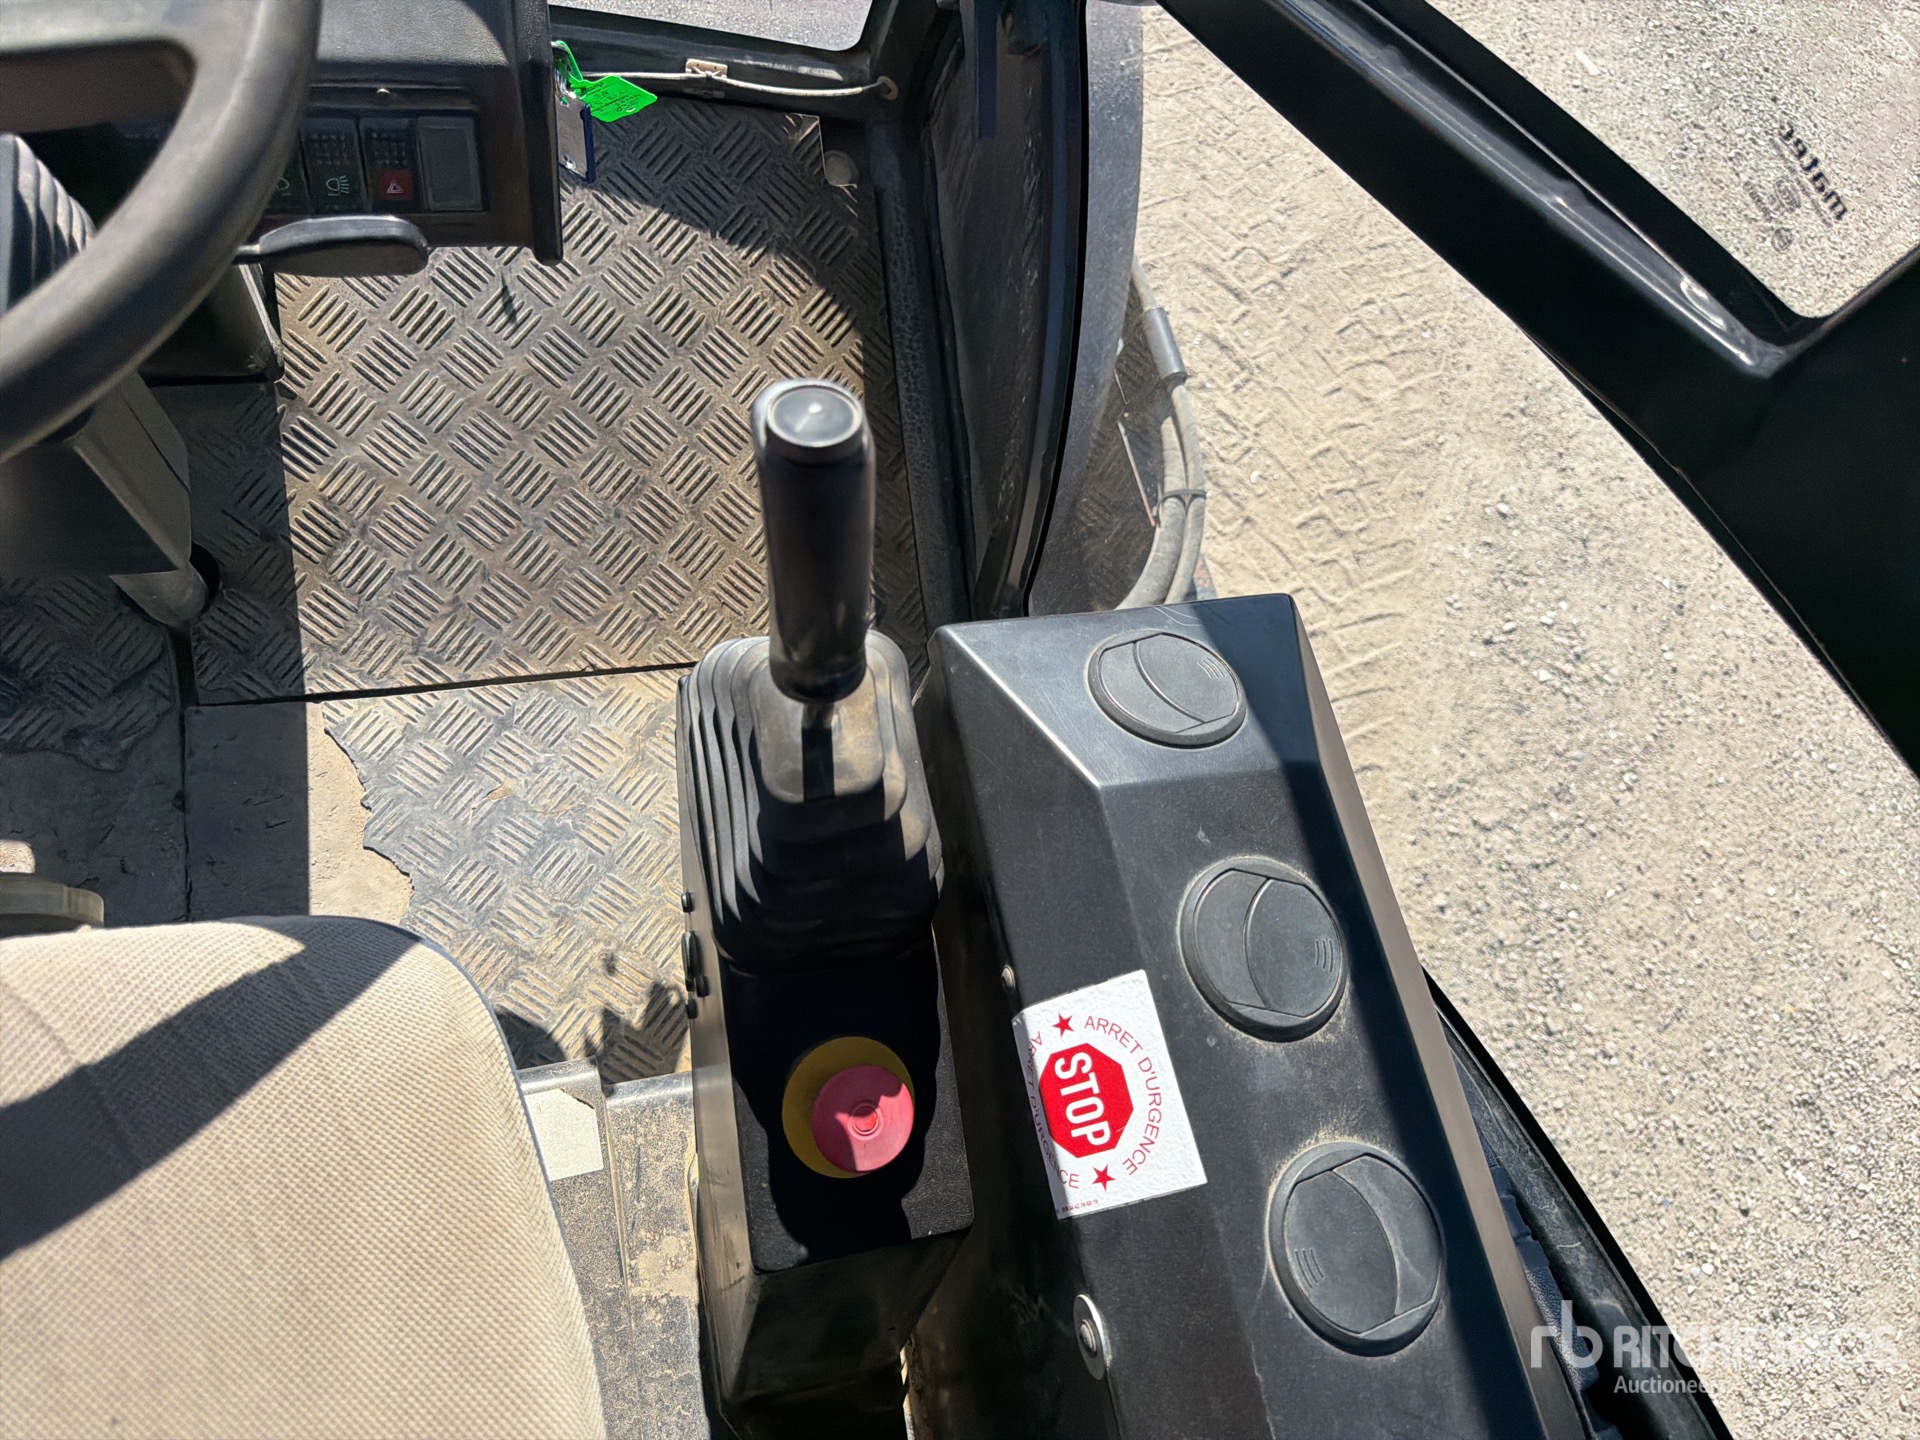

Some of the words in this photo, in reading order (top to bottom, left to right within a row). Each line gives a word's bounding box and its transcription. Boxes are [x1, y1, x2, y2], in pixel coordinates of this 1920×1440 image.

[1054, 1051, 1112, 1147] STOP
[1084, 1015, 1144, 1055] ARRET
[1122, 1056, 1163, 1176] D'URGENCE
